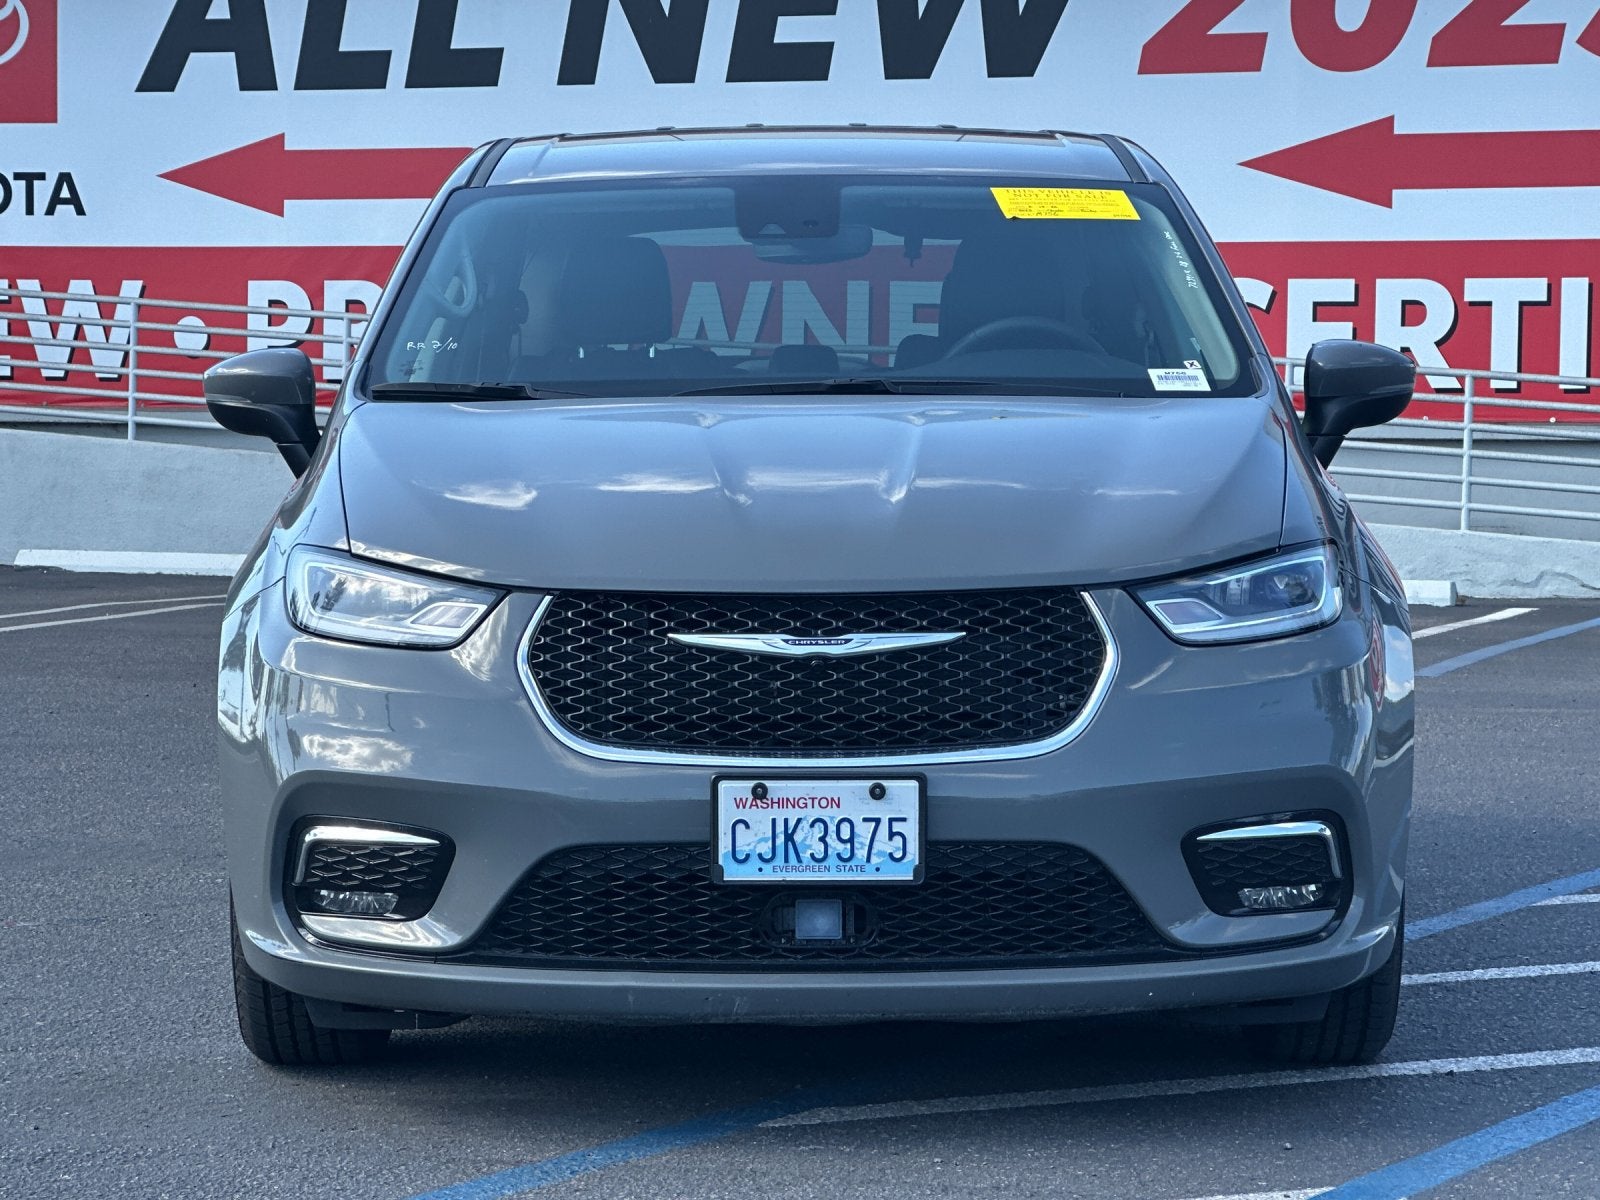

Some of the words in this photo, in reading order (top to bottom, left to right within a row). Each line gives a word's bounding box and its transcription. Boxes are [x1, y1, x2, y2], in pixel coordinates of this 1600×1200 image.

[0, 170, 87, 217] TA
[733, 796, 841, 810] WASHINGTON
[730, 816, 908, 864] CJK3975
[772, 864, 831, 874] EVERGREEN
[835, 864, 867, 874] STATE
